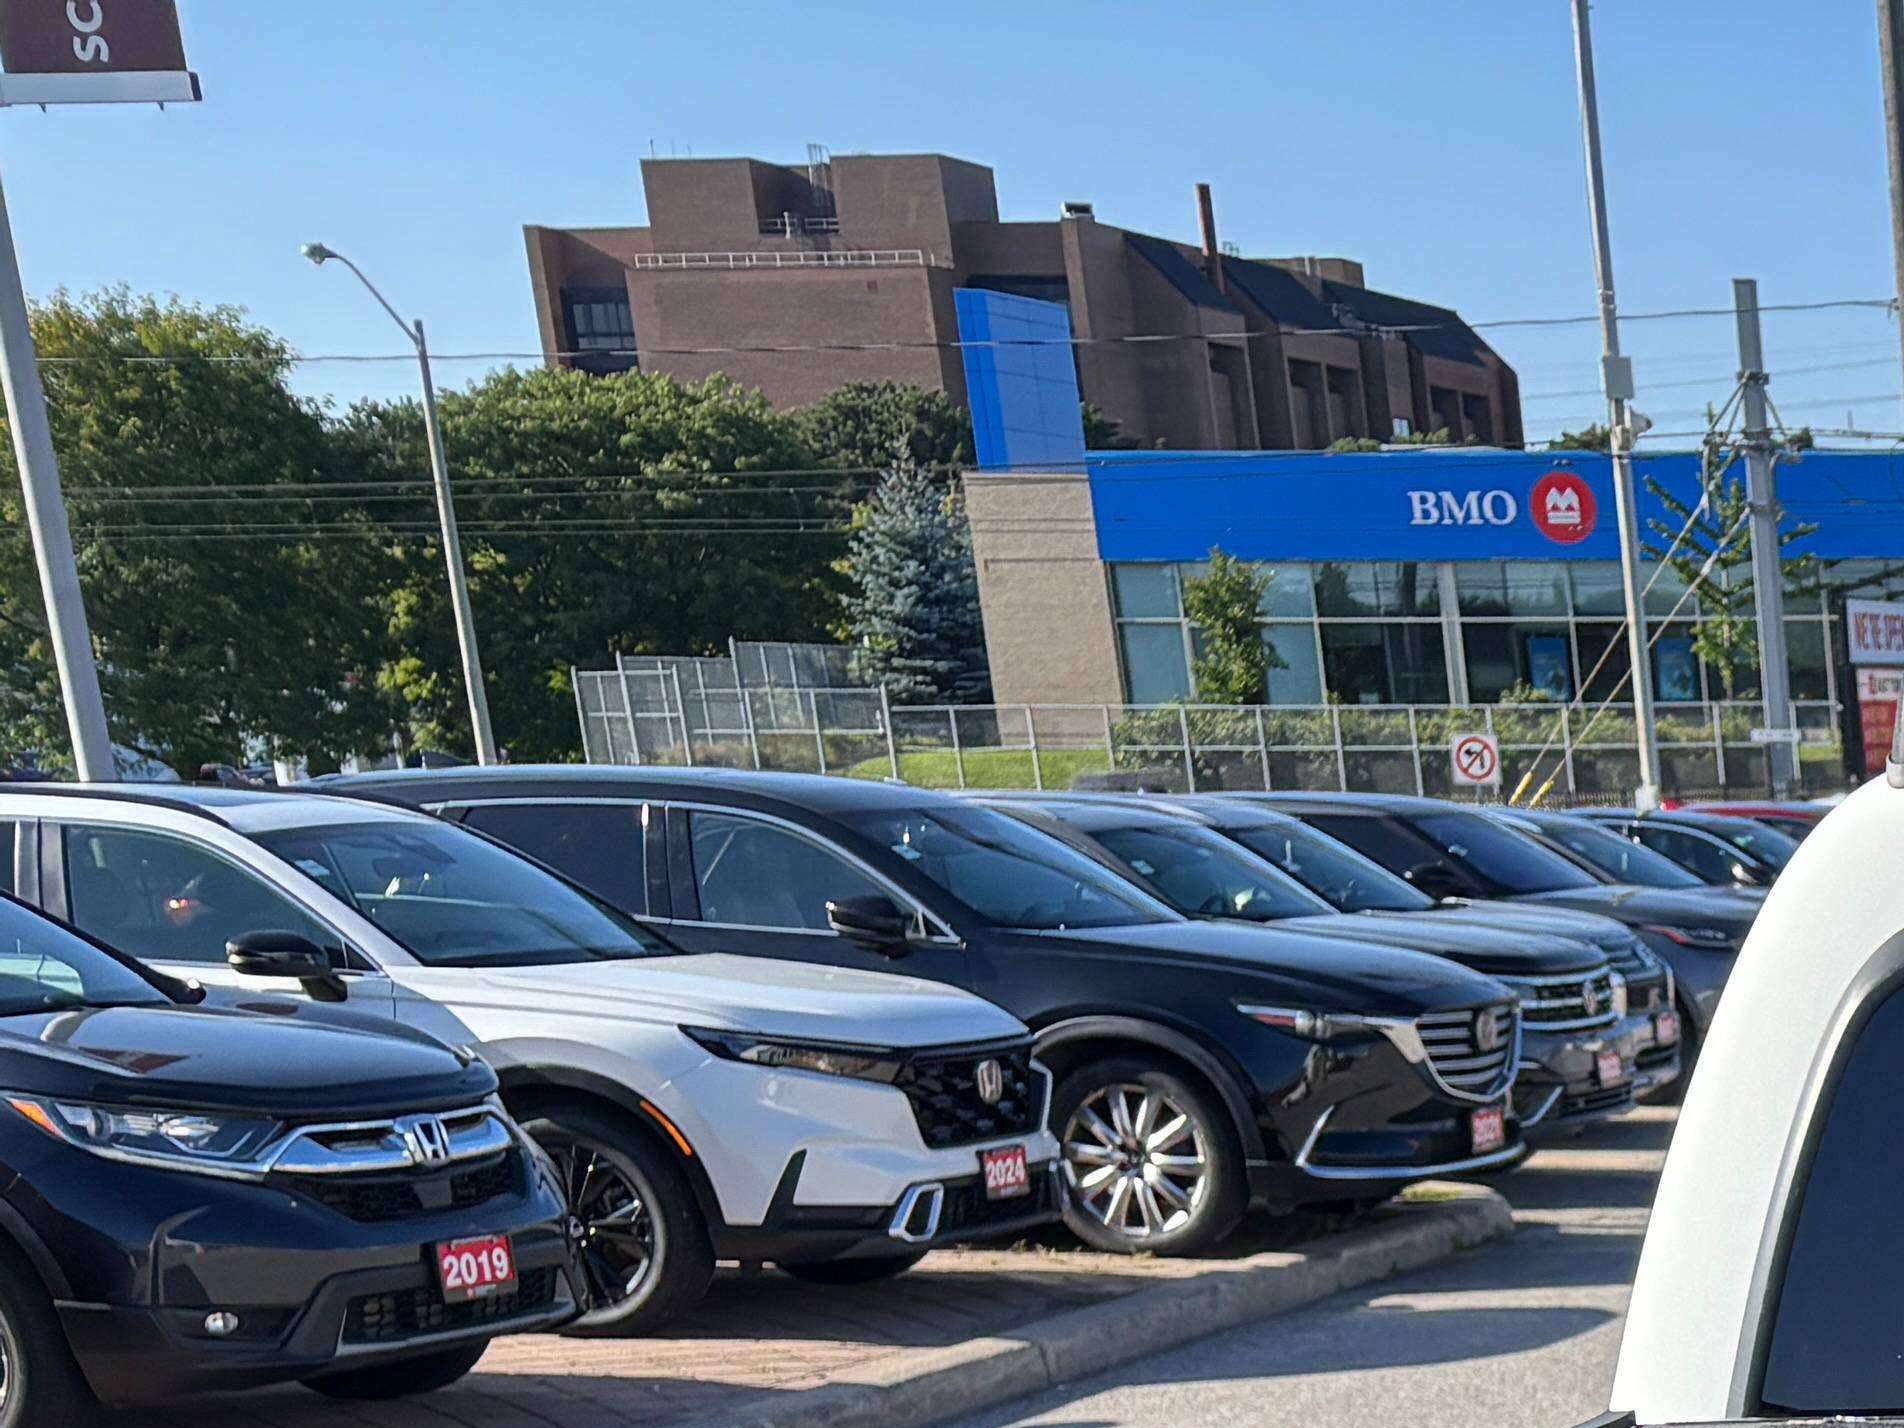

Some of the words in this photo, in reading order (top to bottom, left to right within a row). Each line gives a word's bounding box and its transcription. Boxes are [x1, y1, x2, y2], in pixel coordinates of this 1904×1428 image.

[1407, 489, 1518, 525] BMO
[985, 1155, 1026, 1188] 2024
[443, 1246, 509, 1290] 2019
